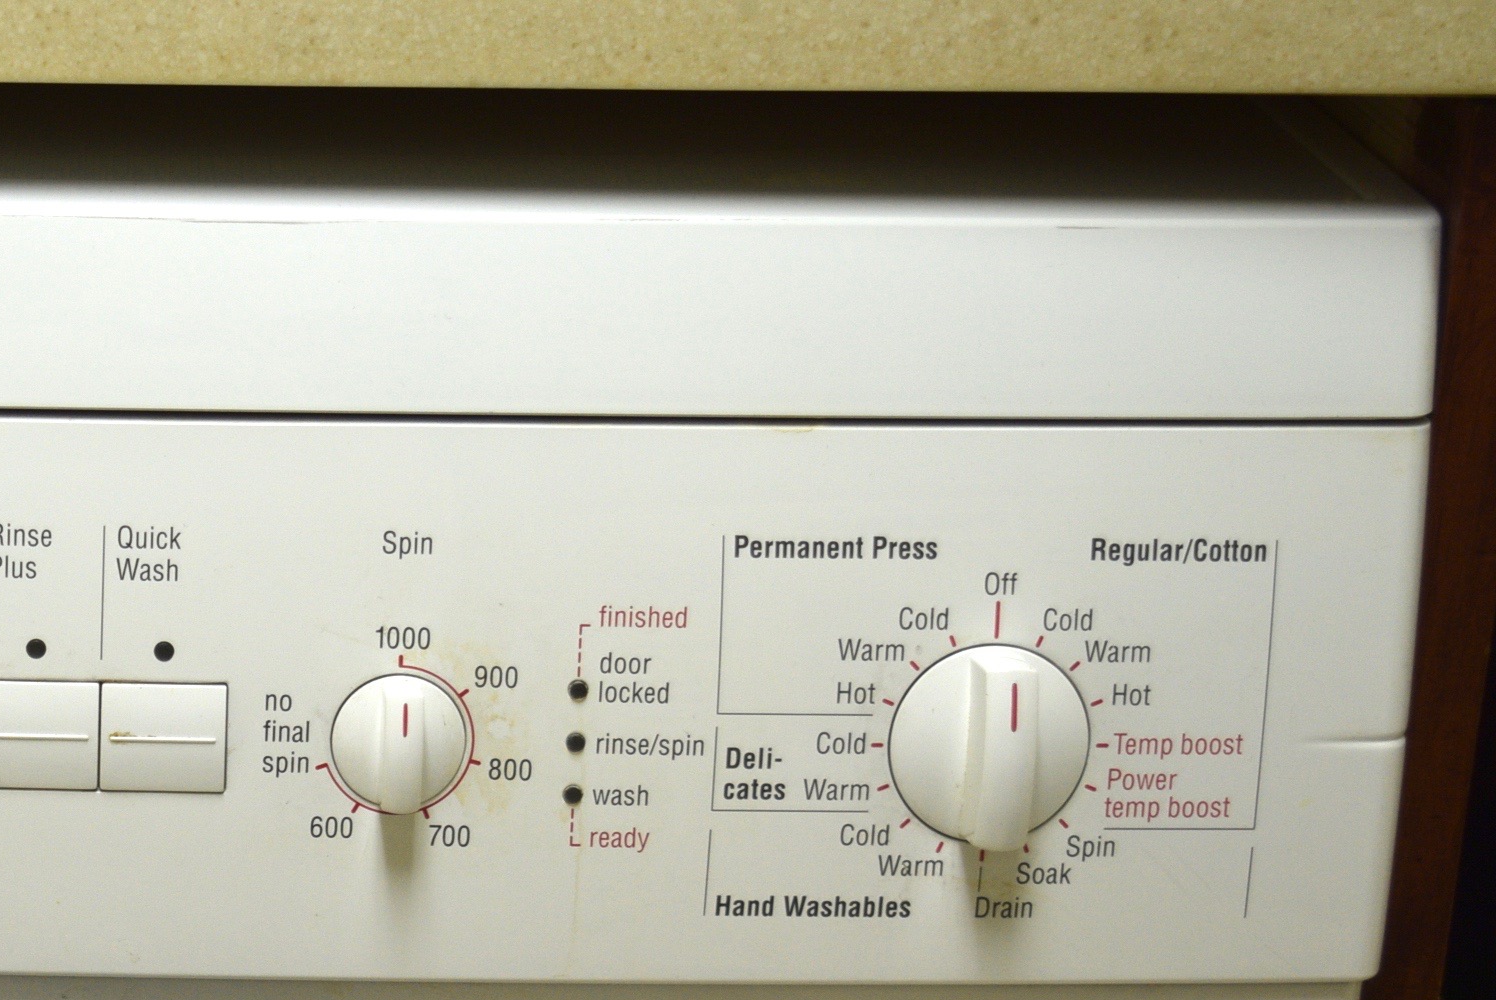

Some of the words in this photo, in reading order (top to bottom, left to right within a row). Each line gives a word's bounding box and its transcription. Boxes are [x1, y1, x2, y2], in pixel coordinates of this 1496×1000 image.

[117, 524, 182, 551] Quick
[382, 529, 434, 560] Spin
[734, 534, 865, 560] Permanent
[872, 535, 939, 561] Press
[1090, 536, 1268, 567] Regular/Cotton
[115, 557, 179, 582] Wash
[984, 571, 1019, 596] Off
[598, 604, 689, 629] finished
[898, 605, 950, 631] Cold
[1043, 607, 1094, 632] Cold
[375, 625, 432, 651] 1000
[837, 637, 906, 662] Warm
[599, 651, 653, 675] door
[1084, 639, 1152, 664] Warm
[474, 664, 519, 690] 900
[264, 693, 293, 713] no
[598, 680, 671, 705] locked
[836, 681, 877, 705] Hot
[1112, 683, 1152, 707] Hot
[262, 719, 311, 744] final
[816, 731, 867, 755] Cold
[595, 733, 705, 761] rinse/spin
[725, 746, 783, 770] Deli-
[1113, 732, 1174, 760] Temp
[1180, 732, 1244, 756] boost
[262, 751, 310, 779] spin
[488, 757, 533, 782] 800
[723, 778, 787, 801] cates
[803, 778, 870, 801] Warm
[1107, 767, 1178, 791] Power
[592, 784, 650, 807] wash
[1104, 797, 1161, 823] temp
[1168, 796, 1231, 819] boost
[309, 815, 354, 839] 600
[429, 824, 471, 848] 700
[840, 823, 891, 847] Cold
[589, 826, 650, 854] ready
[1066, 834, 1116, 862] Spin
[878, 854, 944, 877] Warm
[1015, 861, 1072, 885] Soak
[714, 894, 776, 918] Hand
[783, 894, 912, 919] Washables
[974, 896, 1034, 920] Drain
